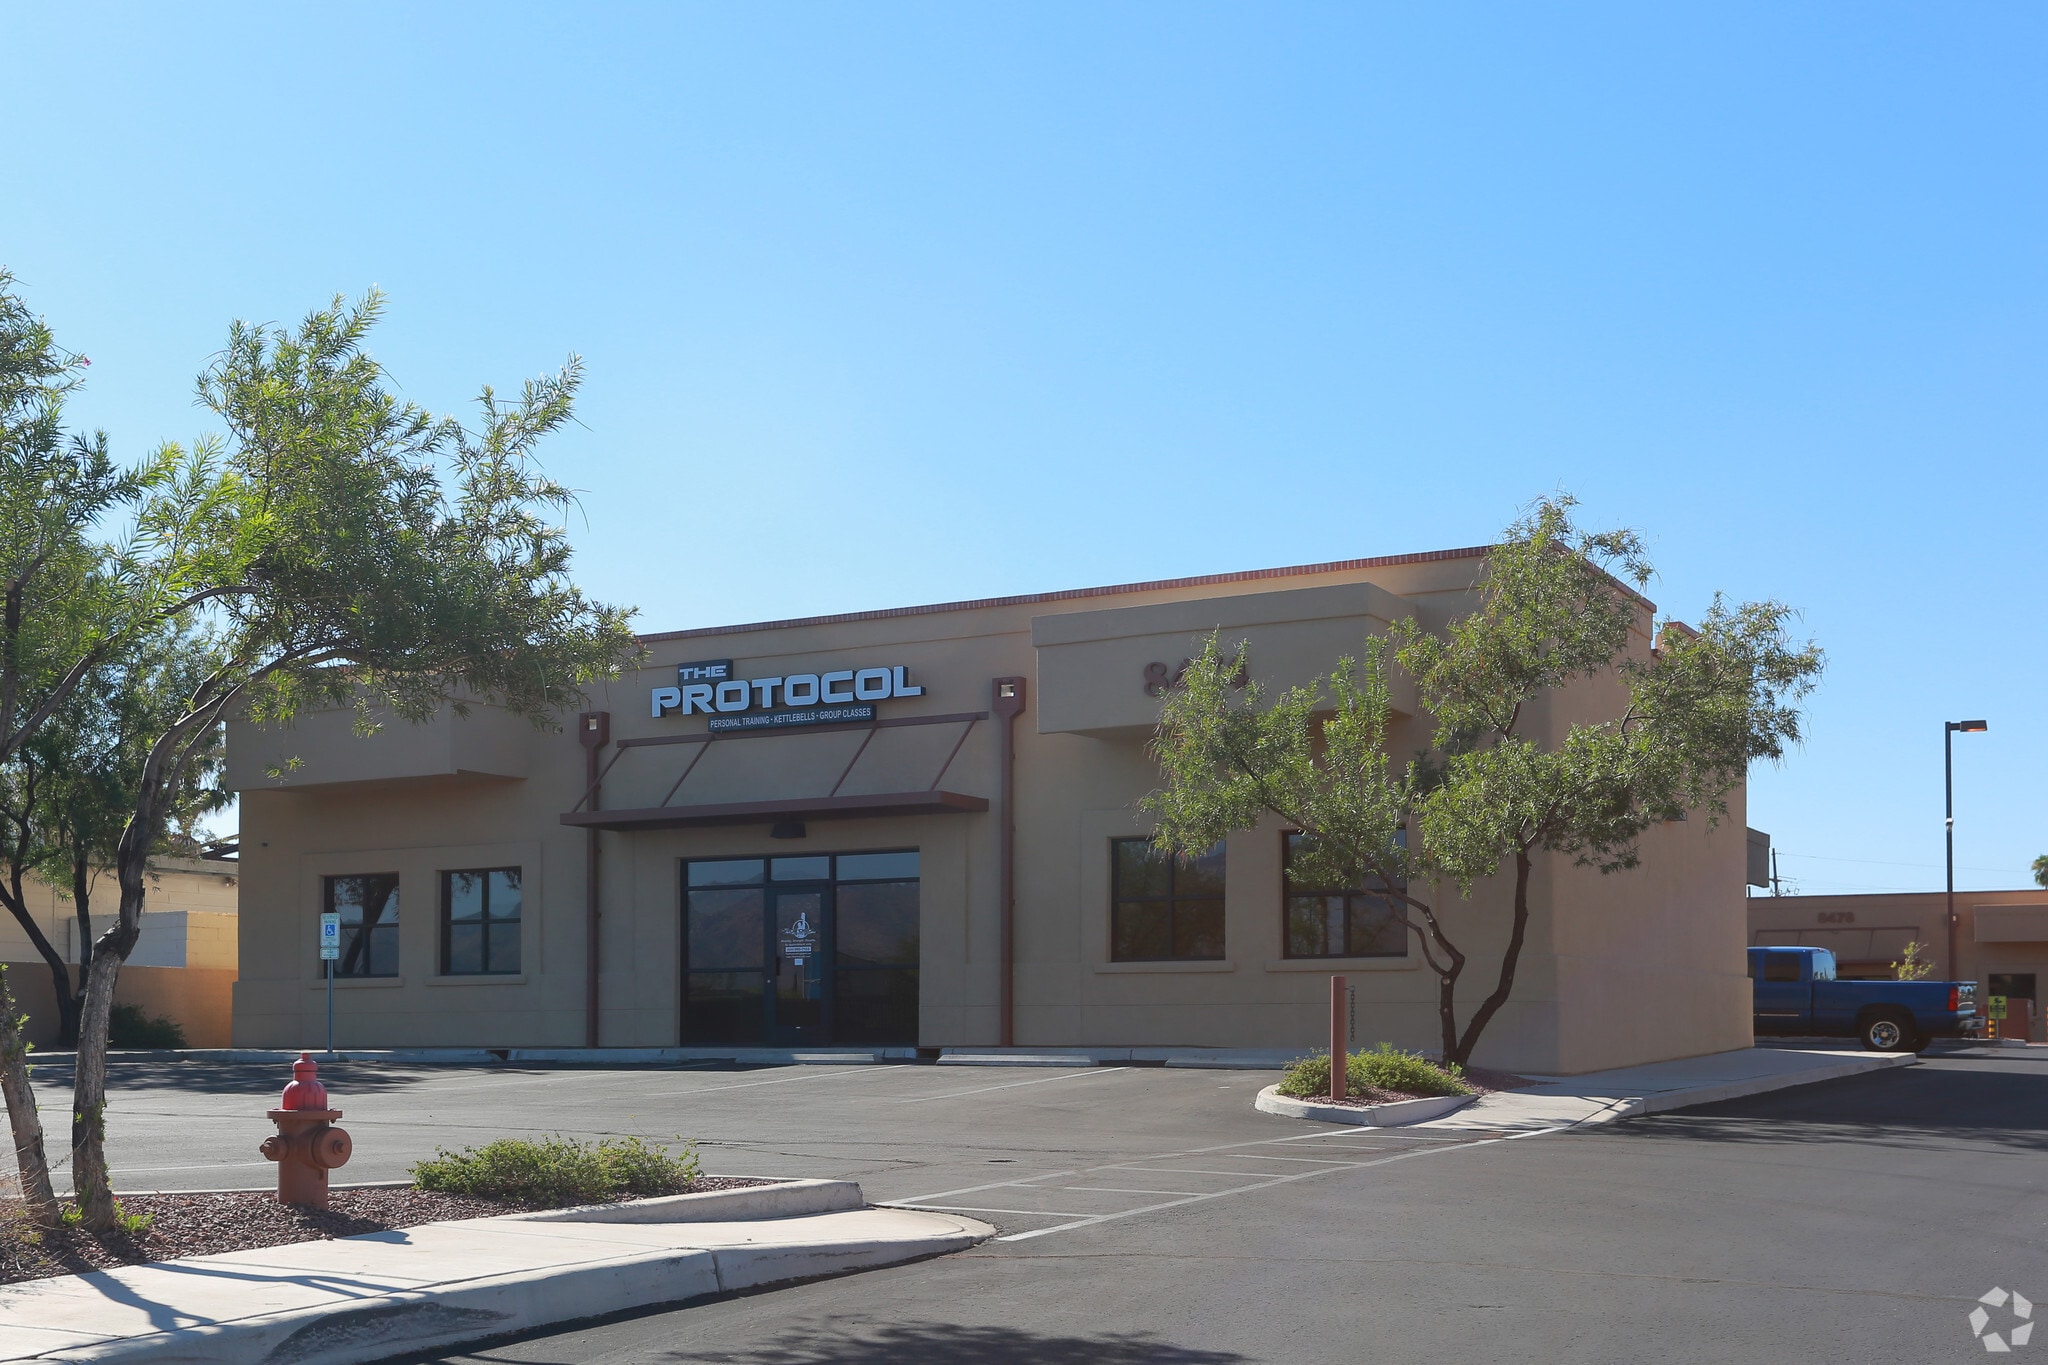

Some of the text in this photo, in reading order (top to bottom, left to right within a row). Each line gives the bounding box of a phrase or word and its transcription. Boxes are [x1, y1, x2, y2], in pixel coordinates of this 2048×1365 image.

[679, 664, 727, 680] THE
[651, 665, 924, 718] PROTOCOL
[710, 707, 871, 728] PERSONAL TRAINING KETTLEBELLS GROUP CLASSES
